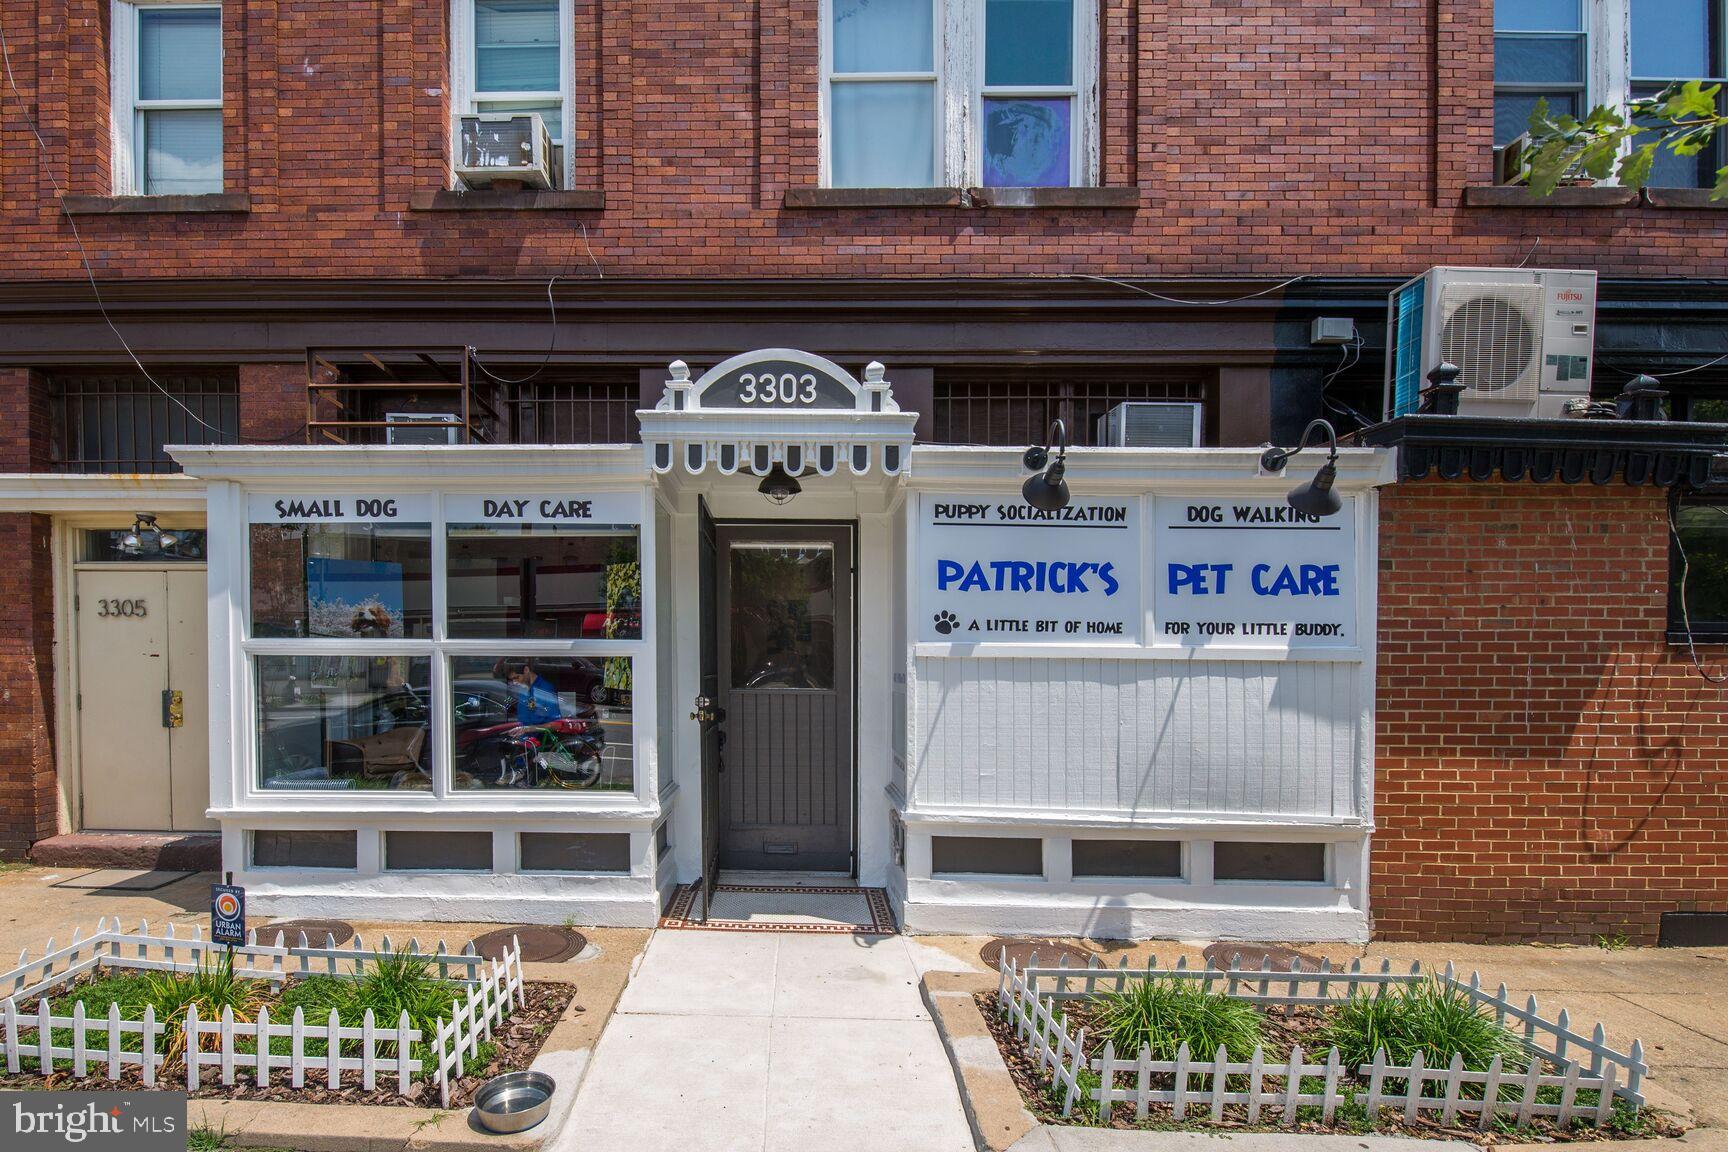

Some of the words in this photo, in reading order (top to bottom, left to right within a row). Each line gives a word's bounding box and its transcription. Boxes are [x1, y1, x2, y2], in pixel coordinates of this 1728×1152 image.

[1557, 291, 1582, 301] FUJITSU
[739, 373, 817, 403] 3303
[274, 499, 344, 519] SMALL
[356, 499, 397, 518] DOG
[483, 500, 530, 518] DAY
[539, 500, 592, 519] CARE
[934, 504, 991, 519] PUPPY
[997, 504, 1127, 521] SOCIALIZATION
[1187, 506, 1223, 523] DOG
[937, 559, 1119, 597] PATRICK'S
[1168, 563, 1233, 595] PET
[1251, 563, 1340, 597] CARE
[97, 599, 147, 617] 3305
[968, 619, 980, 631] A
[987, 619, 1029, 632] LITTLE
[1035, 620, 1059, 632] BIT
[1065, 621, 1081, 633] OF
[1087, 621, 1123, 634] HOME
[1164, 622, 1190, 635] FOR
[1196, 622, 1235, 635] YOUR
[1242, 622, 1287, 636] LITTLE
[1295, 623, 1345, 637] BUDDY.
[215, 920, 241, 930] URBAN
[215, 928, 242, 937] ALARM
